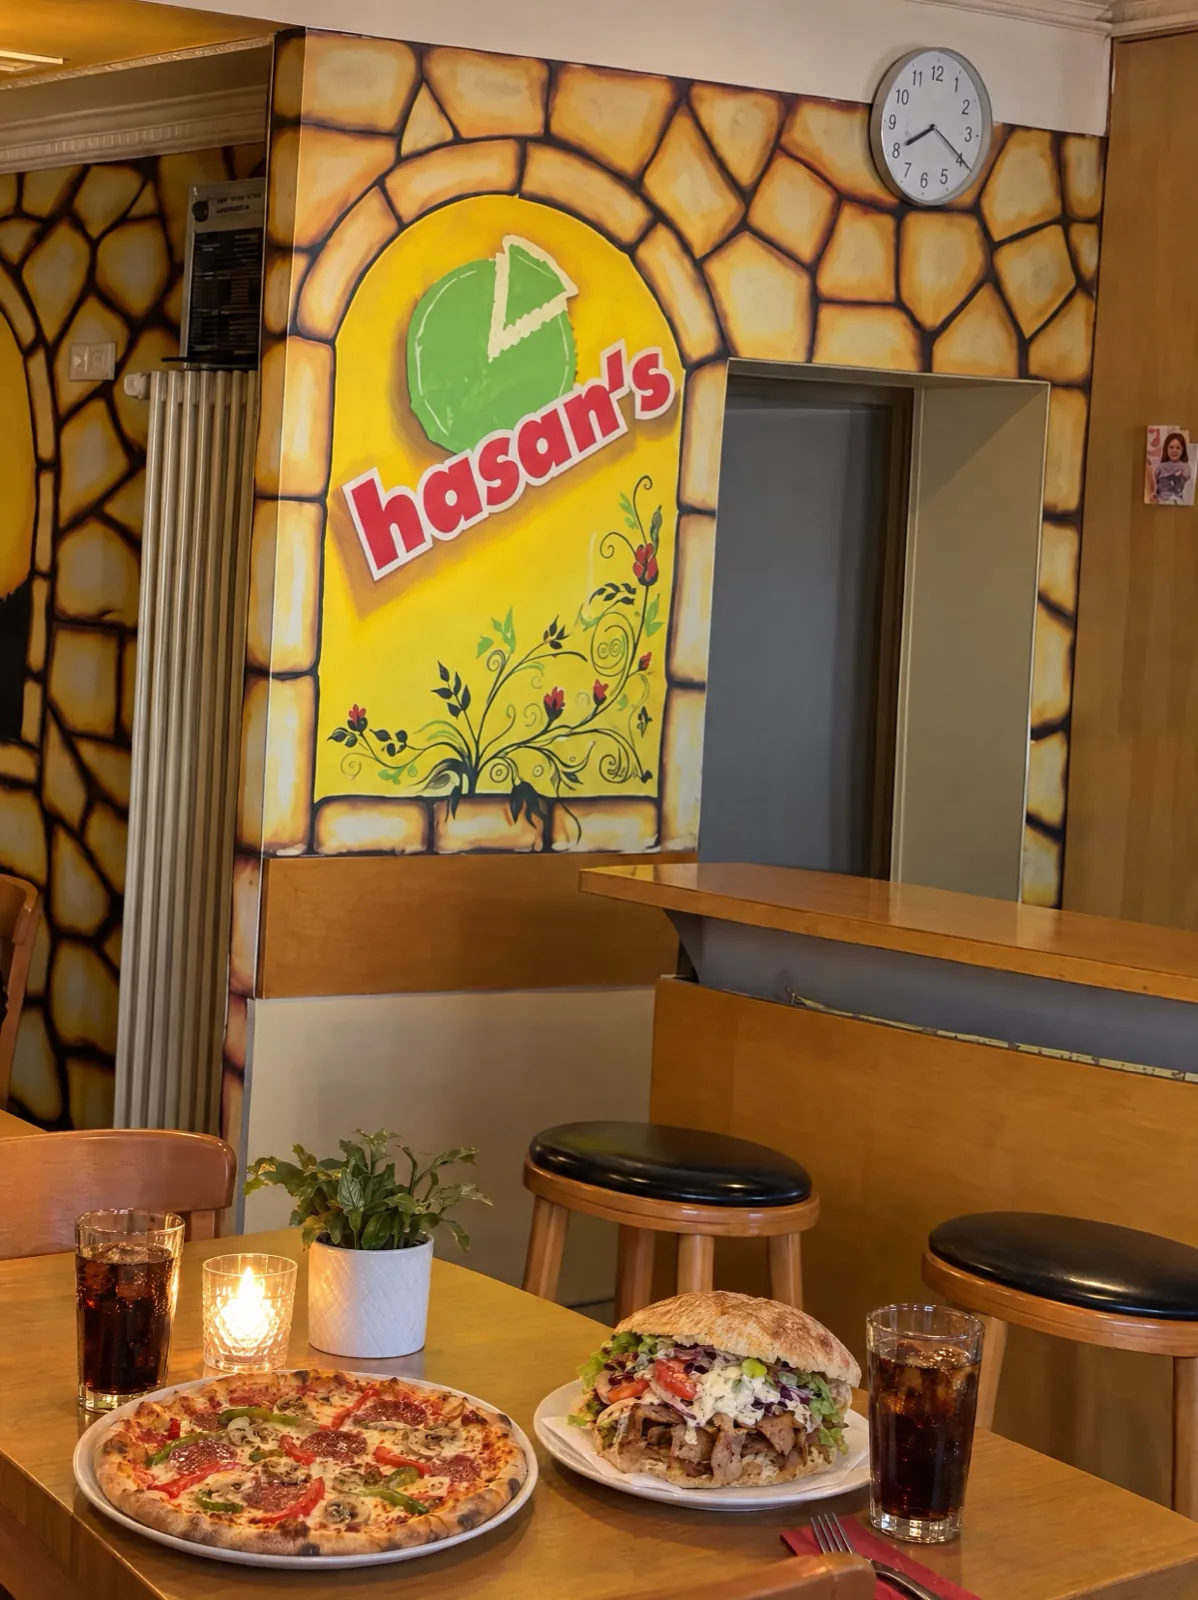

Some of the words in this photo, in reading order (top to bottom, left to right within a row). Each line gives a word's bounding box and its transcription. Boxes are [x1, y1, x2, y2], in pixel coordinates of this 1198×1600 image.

[912, 69, 923, 87] 11
[931, 65, 944, 82] 12
[954, 76, 959, 93] 1
[895, 88, 909, 105] 10
[961, 99, 970, 115] 2
[888, 114, 896, 130] 9
[964, 126, 972, 142] 3
[892, 142, 900, 159] 8
[955, 152, 963, 167] 4
[904, 162, 912, 178] 7
[939, 168, 948, 185] 5
[920, 172, 928, 188] 6
[345, 341, 675, 580] hasan's
